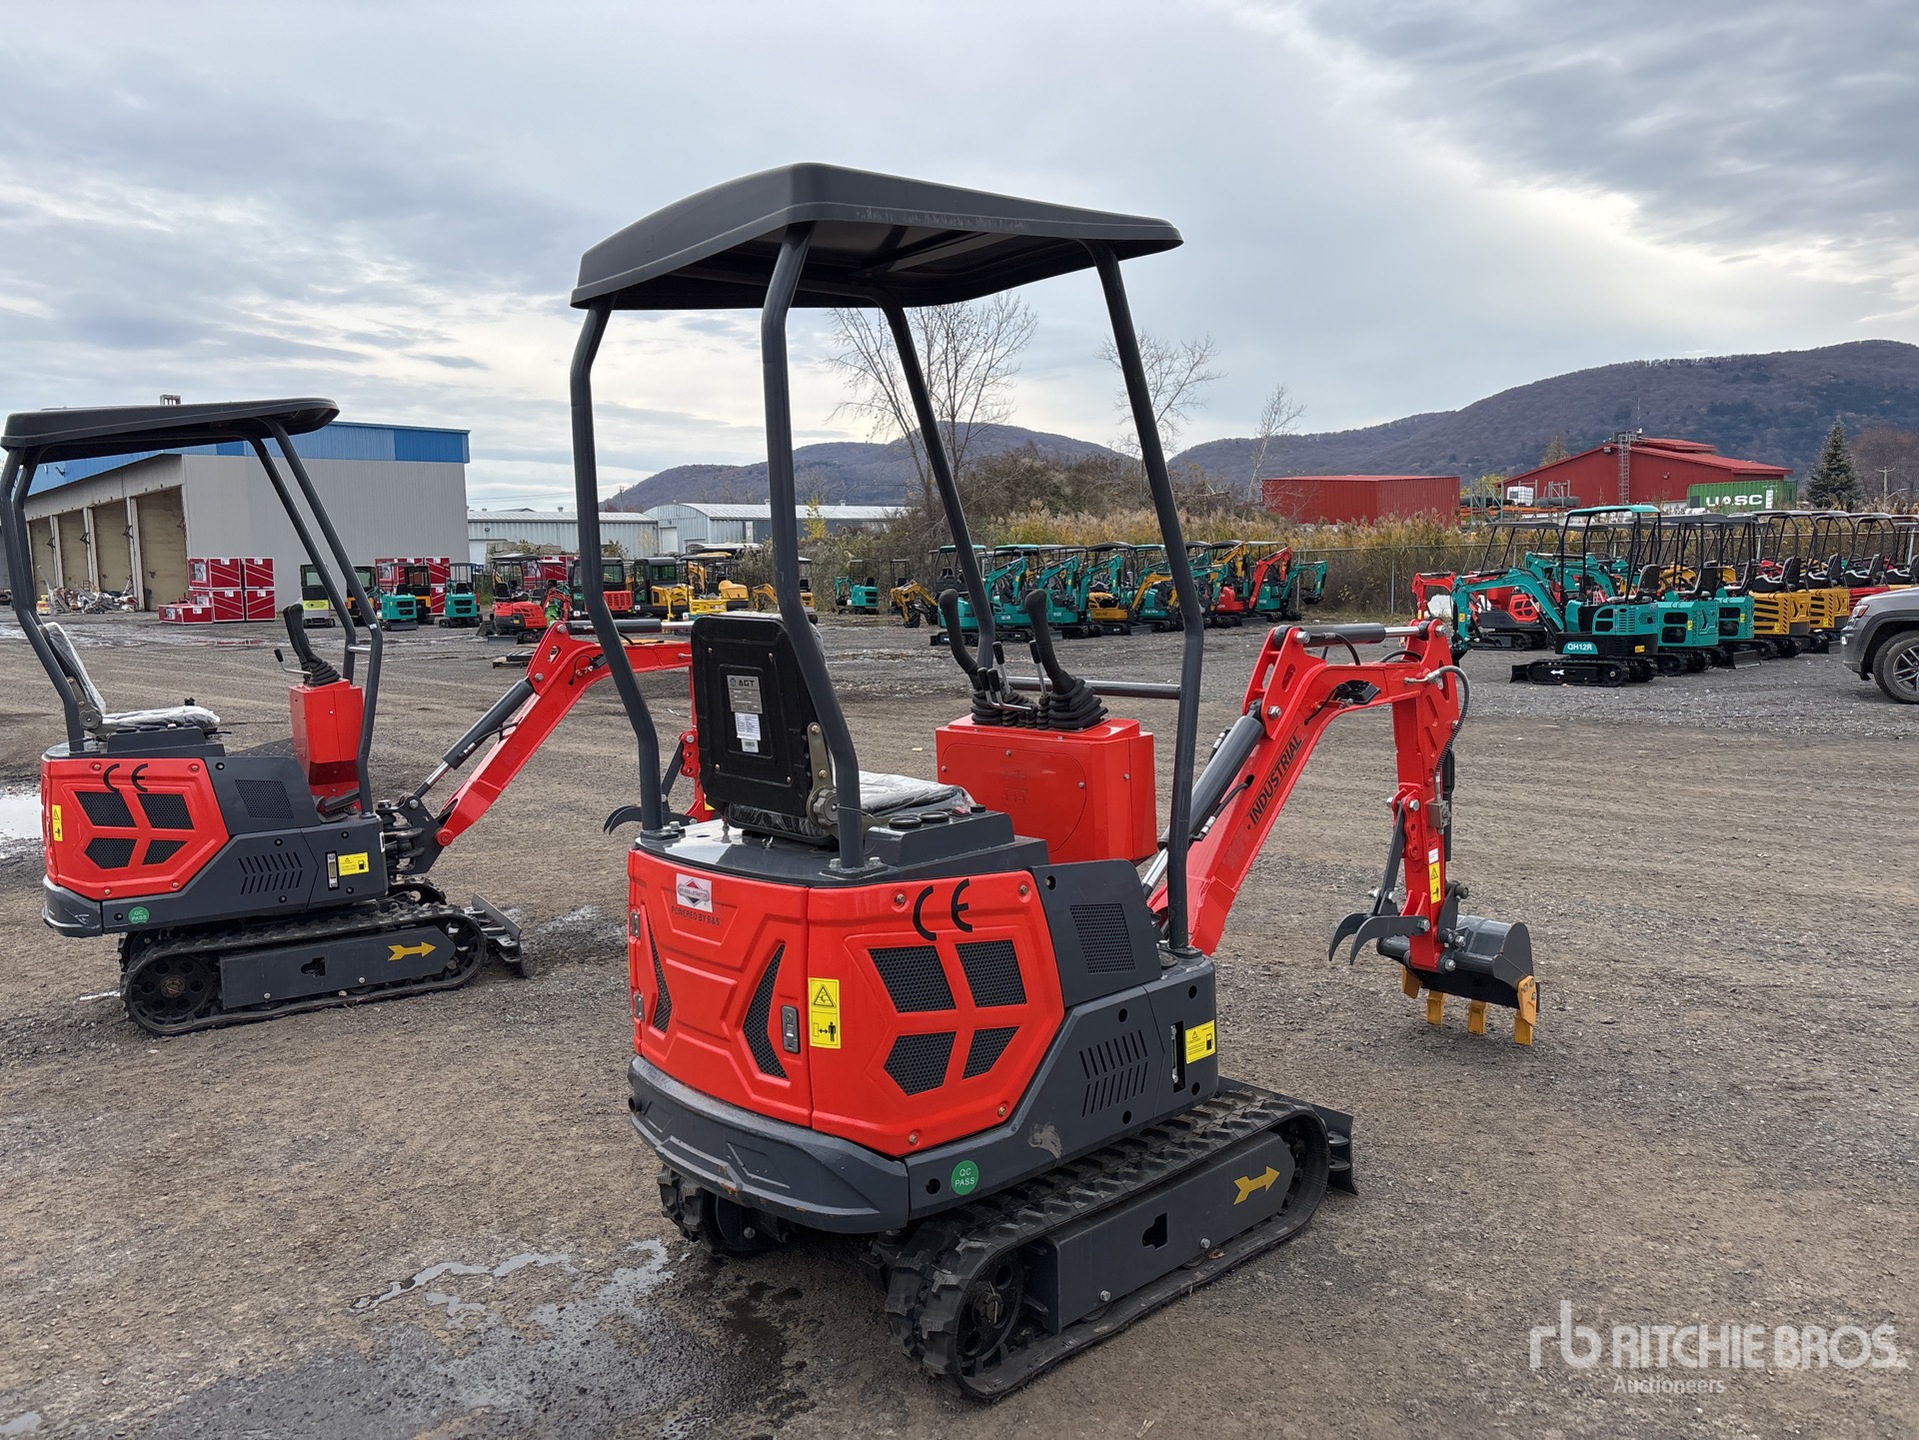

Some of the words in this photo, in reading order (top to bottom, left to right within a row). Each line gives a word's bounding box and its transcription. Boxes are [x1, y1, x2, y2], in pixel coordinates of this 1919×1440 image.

[738, 679, 755, 687] AGT
[103, 763, 148, 793] CE
[1248, 735, 1303, 826] INDUSTRIAL
[671, 905, 698, 921] POWERED
[698, 913, 707, 922] BY
[912, 878, 974, 942] CE
[959, 1167, 972, 1177] QC
[955, 1176, 976, 1188] PASS
